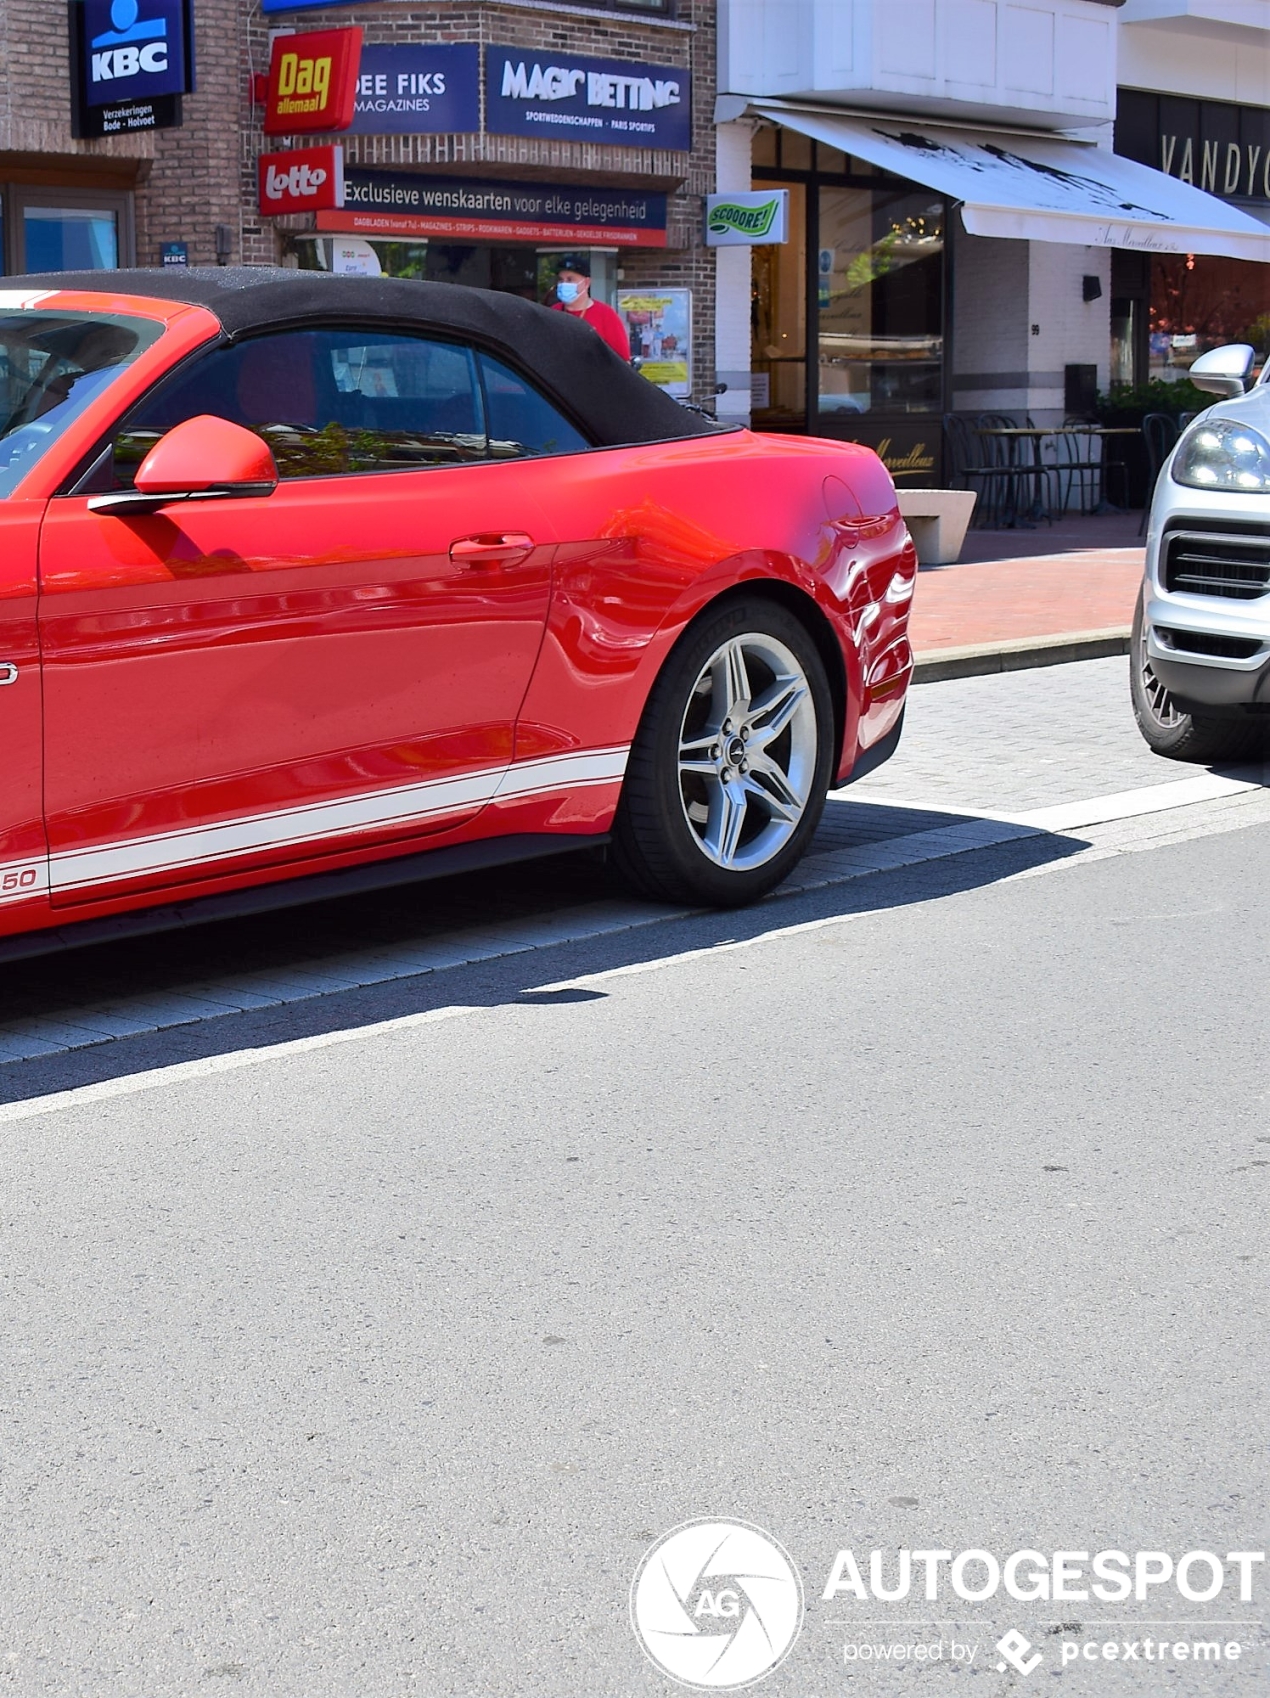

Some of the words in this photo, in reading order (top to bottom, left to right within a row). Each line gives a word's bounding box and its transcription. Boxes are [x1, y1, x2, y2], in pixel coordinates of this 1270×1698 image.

[92, 42, 168, 82] KBC
[278, 53, 332, 110] Dag
[397, 73, 446, 95] FIKS
[501, 60, 585, 101] MAGIC
[587, 71, 681, 111] BETTING
[103, 104, 152, 120] Verzekeringen
[277, 95, 320, 114] allemaal
[354, 98, 430, 112] MAGAZINES
[103, 121, 121, 131] Bode
[127, 115, 155, 128] Holvoet
[526, 111, 603, 128] SPORTWEDDENSCHAPPEN
[611, 119, 628, 131] PARIS
[629, 121, 656, 133] SPORTIFS
[344, 180, 419, 204] Exclusieve
[423, 188, 511, 211] wenskaarten
[514, 197, 542, 213] voor
[545, 195, 571, 215] elke
[574, 199, 647, 222] gelegenheid
[354, 217, 390, 228] DAGBLADEN
[420, 221, 453, 232] MAGAZINES
[455, 223, 475, 232] STRIPS
[711, 207, 769, 229] SCOOORE!
[163, 255, 186, 263] KBC
[1031, 324, 1040, 336] 99
